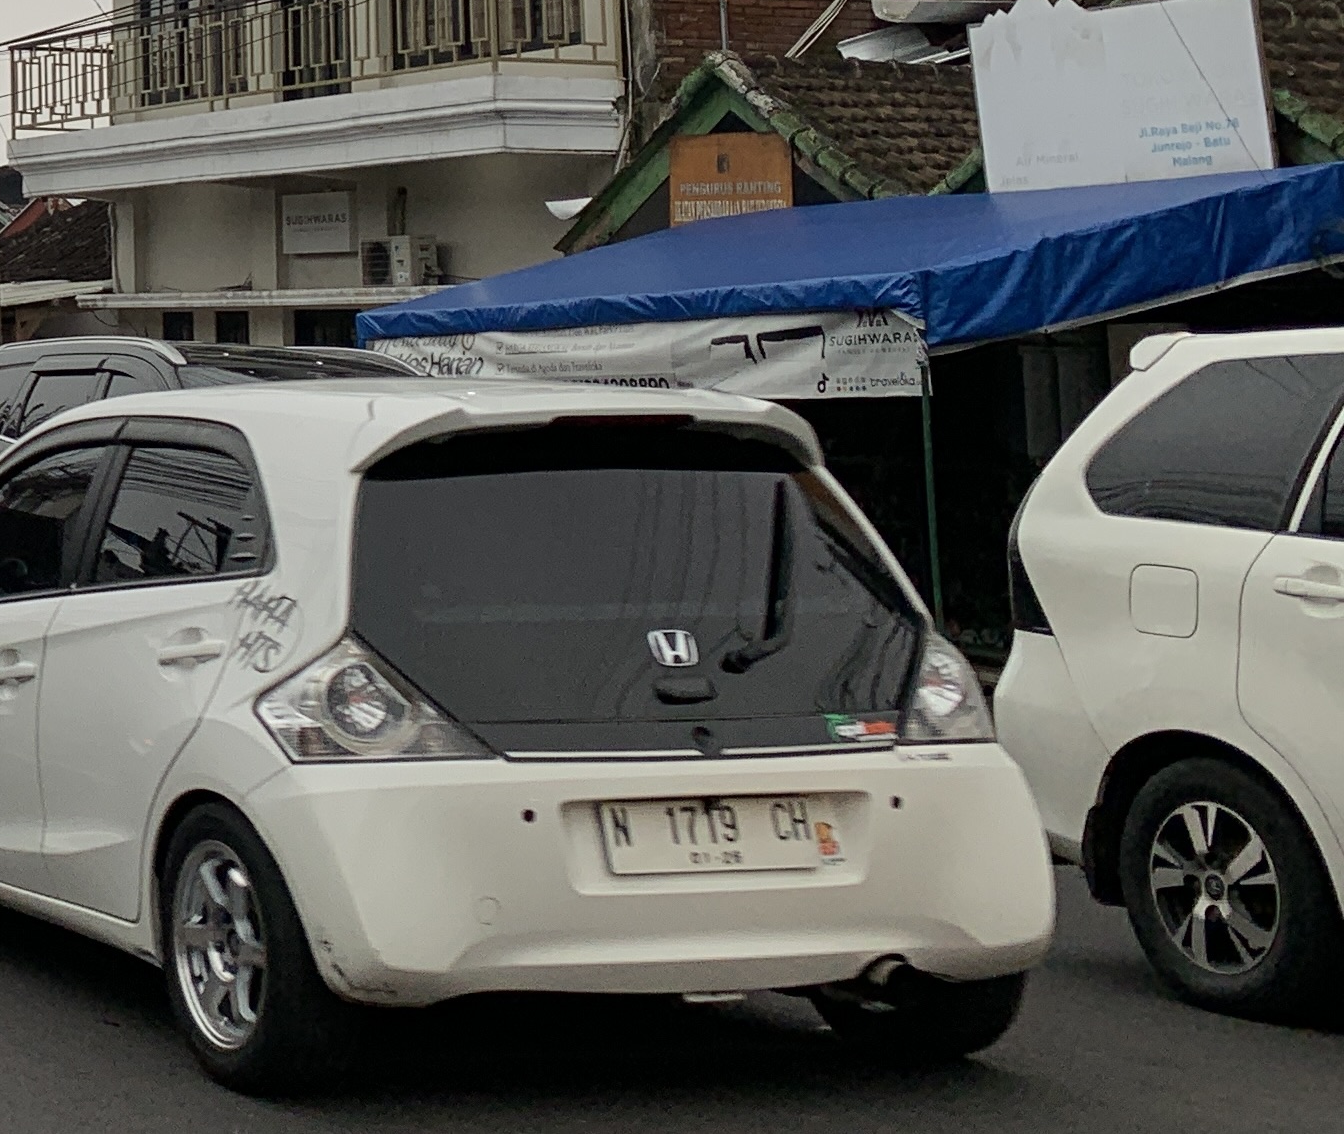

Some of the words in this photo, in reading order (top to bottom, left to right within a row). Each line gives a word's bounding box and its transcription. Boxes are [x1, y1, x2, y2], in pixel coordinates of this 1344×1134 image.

[1203, 137, 1231, 149] Batu
[1172, 153, 1212, 169] Malang
[612, 806, 633, 847] N
[770, 800, 812, 842] CH
